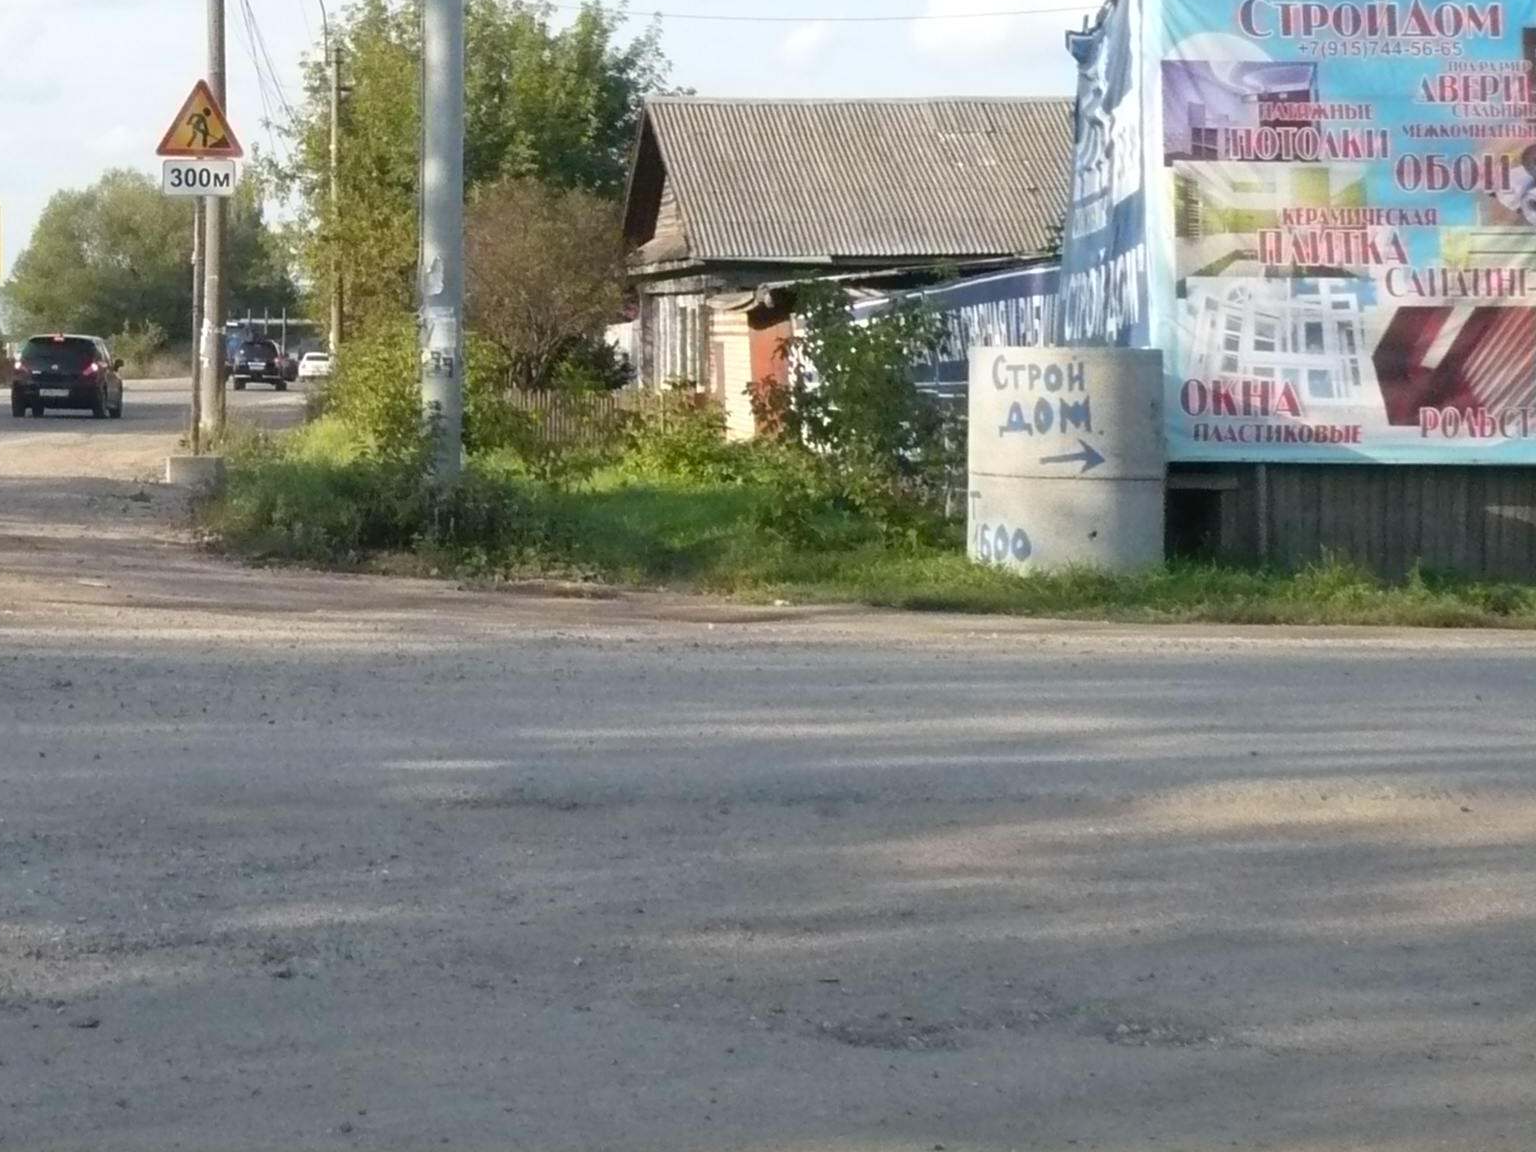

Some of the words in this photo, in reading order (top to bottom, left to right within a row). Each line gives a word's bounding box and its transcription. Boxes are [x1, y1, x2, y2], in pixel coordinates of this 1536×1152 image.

[1298, 40, 1463, 58] +7(915)744-56-65
[1414, 75, 1527, 103] ДВЕРИ
[1258, 102, 1373, 121] НАТЯЖНЫЕ
[1230, 127, 1389, 160] ПОТОЛКИ
[1394, 153, 1512, 192] ОБОИ
[1282, 207, 1438, 227] КЕРАМИЧЕСКАЯ
[1257, 229, 1410, 266] ПЛИТКА
[1180, 378, 1303, 418] ОКНА
[1192, 422, 1363, 445] ПЛАСТИКОВЫЕ
